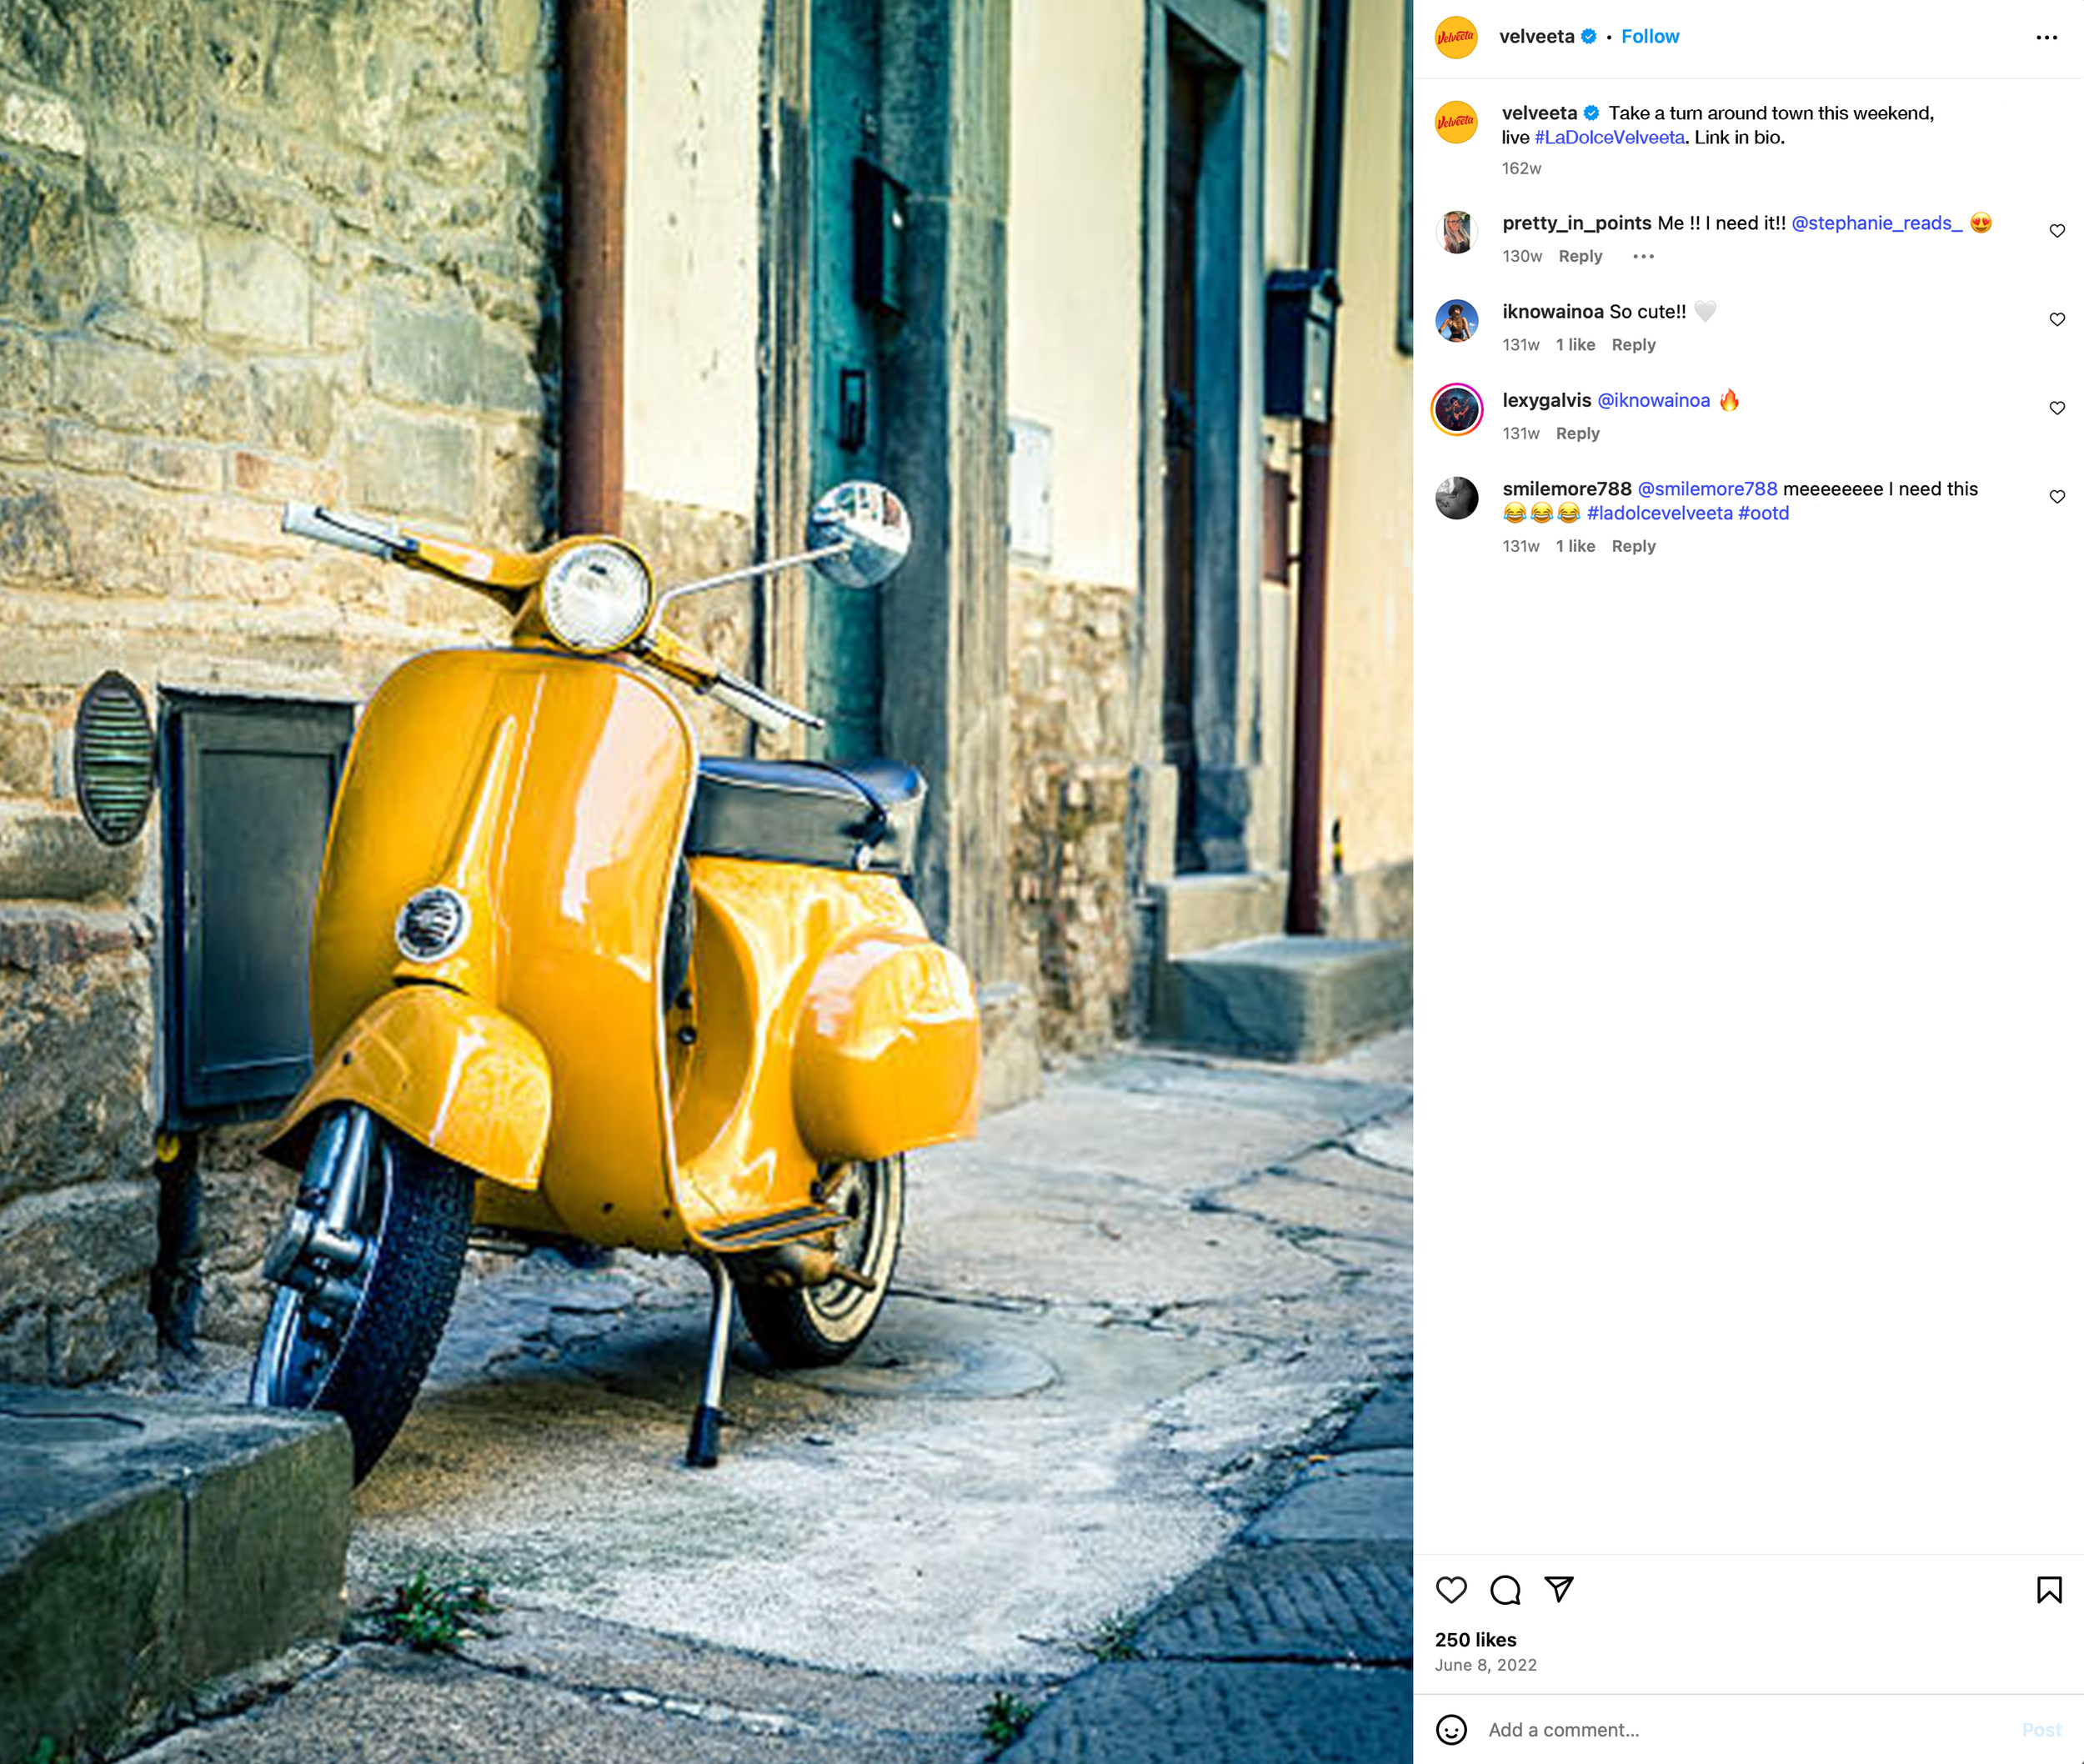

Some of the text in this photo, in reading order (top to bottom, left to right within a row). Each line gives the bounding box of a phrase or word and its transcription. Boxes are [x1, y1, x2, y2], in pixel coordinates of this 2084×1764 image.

[1438, 30, 1474, 45] Velveeta
[1500, 28, 1575, 43] velveeta
[1621, 28, 1681, 43] Follow
[1502, 105, 1934, 123] velveeta Take a turn around town this weekend,
[1438, 115, 1474, 130] Velveeta
[1503, 130, 1785, 144] live #LaDolceVelveeta. Link in bio.
[1503, 162, 1541, 174] 162w
[1503, 214, 1963, 234] pretty_in_points Me !! I need it!! @stephanie_reads_
[1503, 250, 1542, 263] 130w
[1560, 249, 1603, 265] Reply
[1503, 303, 1686, 318] iknowainoa So cute!!
[1503, 338, 1540, 351] 131w
[1556, 338, 1596, 351] 1 like
[1612, 338, 1656, 353] Reply
[1503, 392, 1711, 411] lexygalvis @iknowainoa
[1503, 427, 1540, 439] 131w
[1556, 427, 1600, 443] Reply
[1503, 481, 1978, 498] smilemore788 @smilemore788 meeeeeeee I need this
[1587, 505, 1790, 520] #ladolcevelveeta #ootd
[1503, 540, 1540, 553] 131w
[1556, 539, 1596, 553] 1 like
[1612, 539, 1656, 555] Reply
[1435, 1631, 1516, 1647] 250 likes
[1435, 1659, 1536, 1674] June 8, 2022
[1489, 1722, 1523, 1736] Add
[1529, 1726, 1538, 1736] a
[2022, 1723, 2062, 1736] Post
